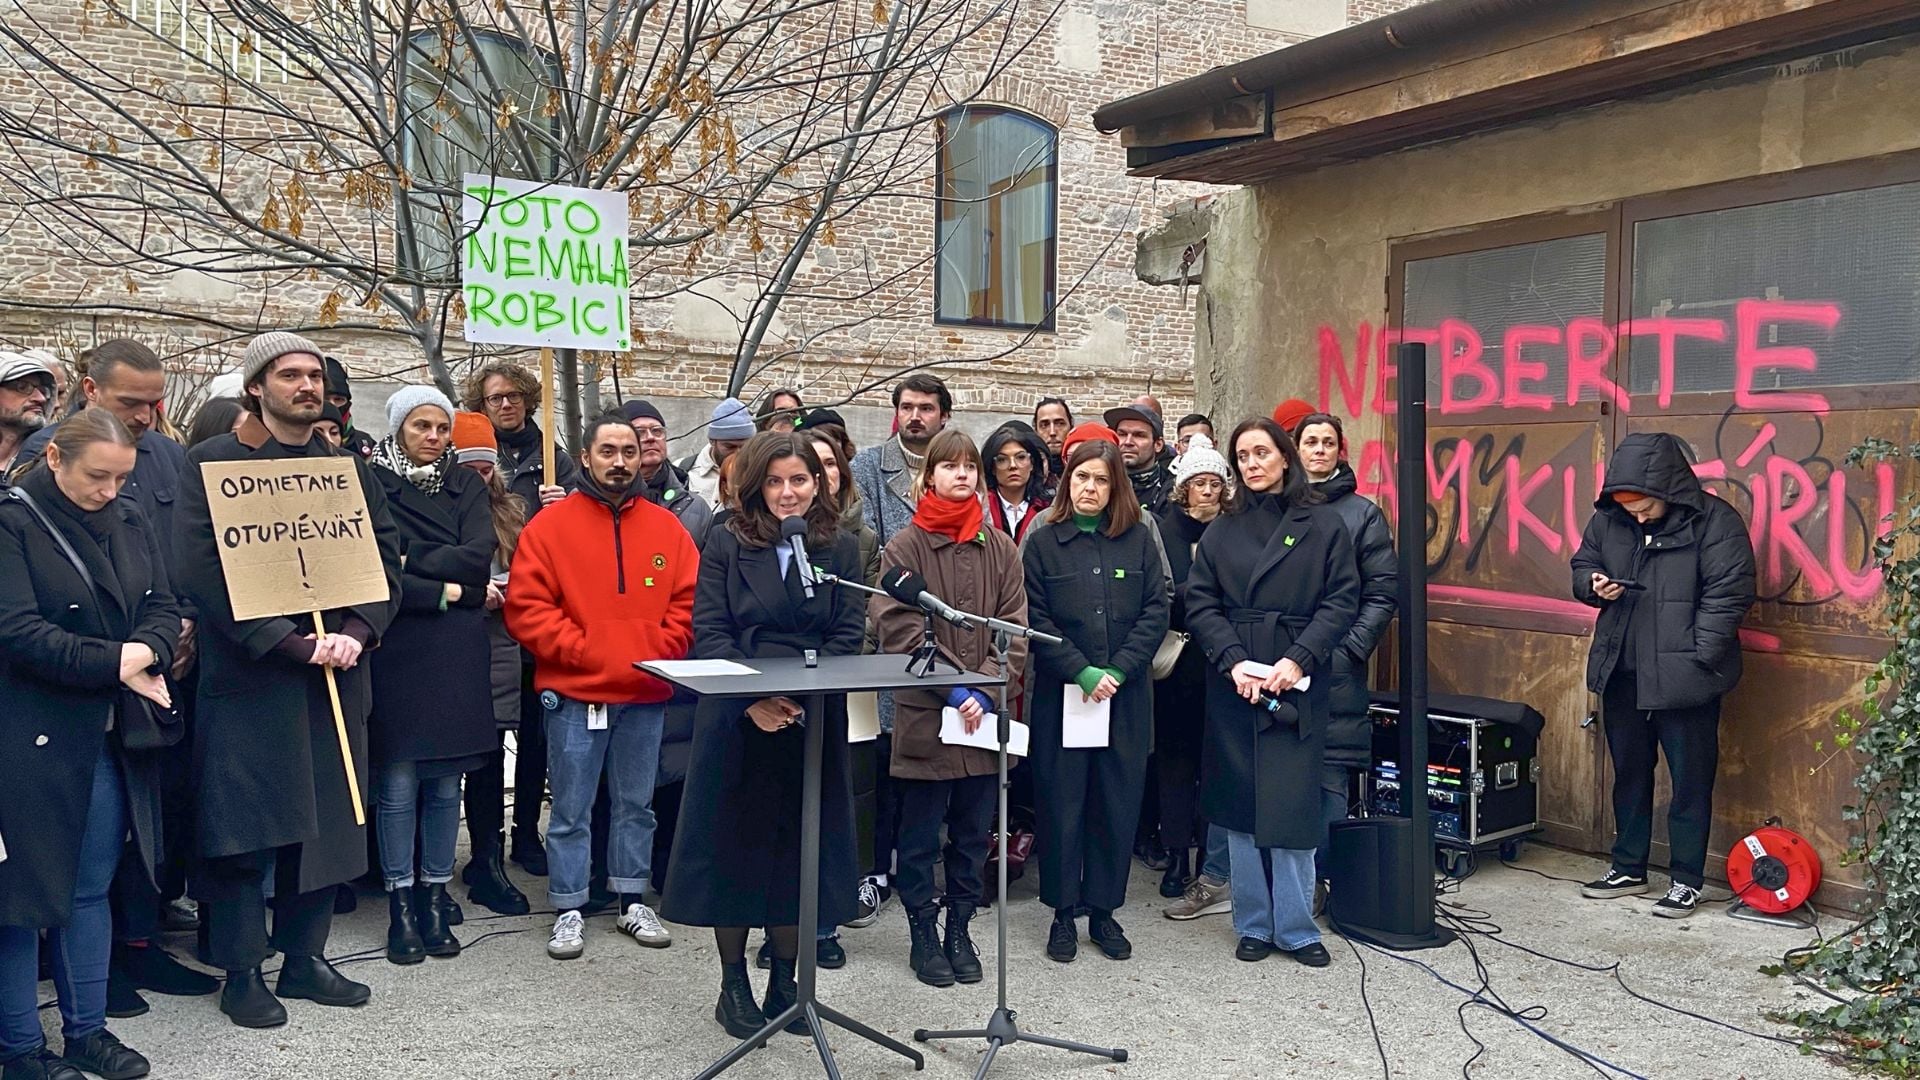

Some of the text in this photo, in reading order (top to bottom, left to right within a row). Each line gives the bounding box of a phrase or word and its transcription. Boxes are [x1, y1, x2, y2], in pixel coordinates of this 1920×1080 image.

[467, 186, 601, 235] TOTO
[468, 229, 628, 289] NEMALA
[465, 284, 629, 349] ROBIC!
[1317, 299, 1843, 419] NEBERTE
[220, 473, 349, 499] ODMIETAME
[223, 508, 364, 549] OTUPJÉVJÄŤ
